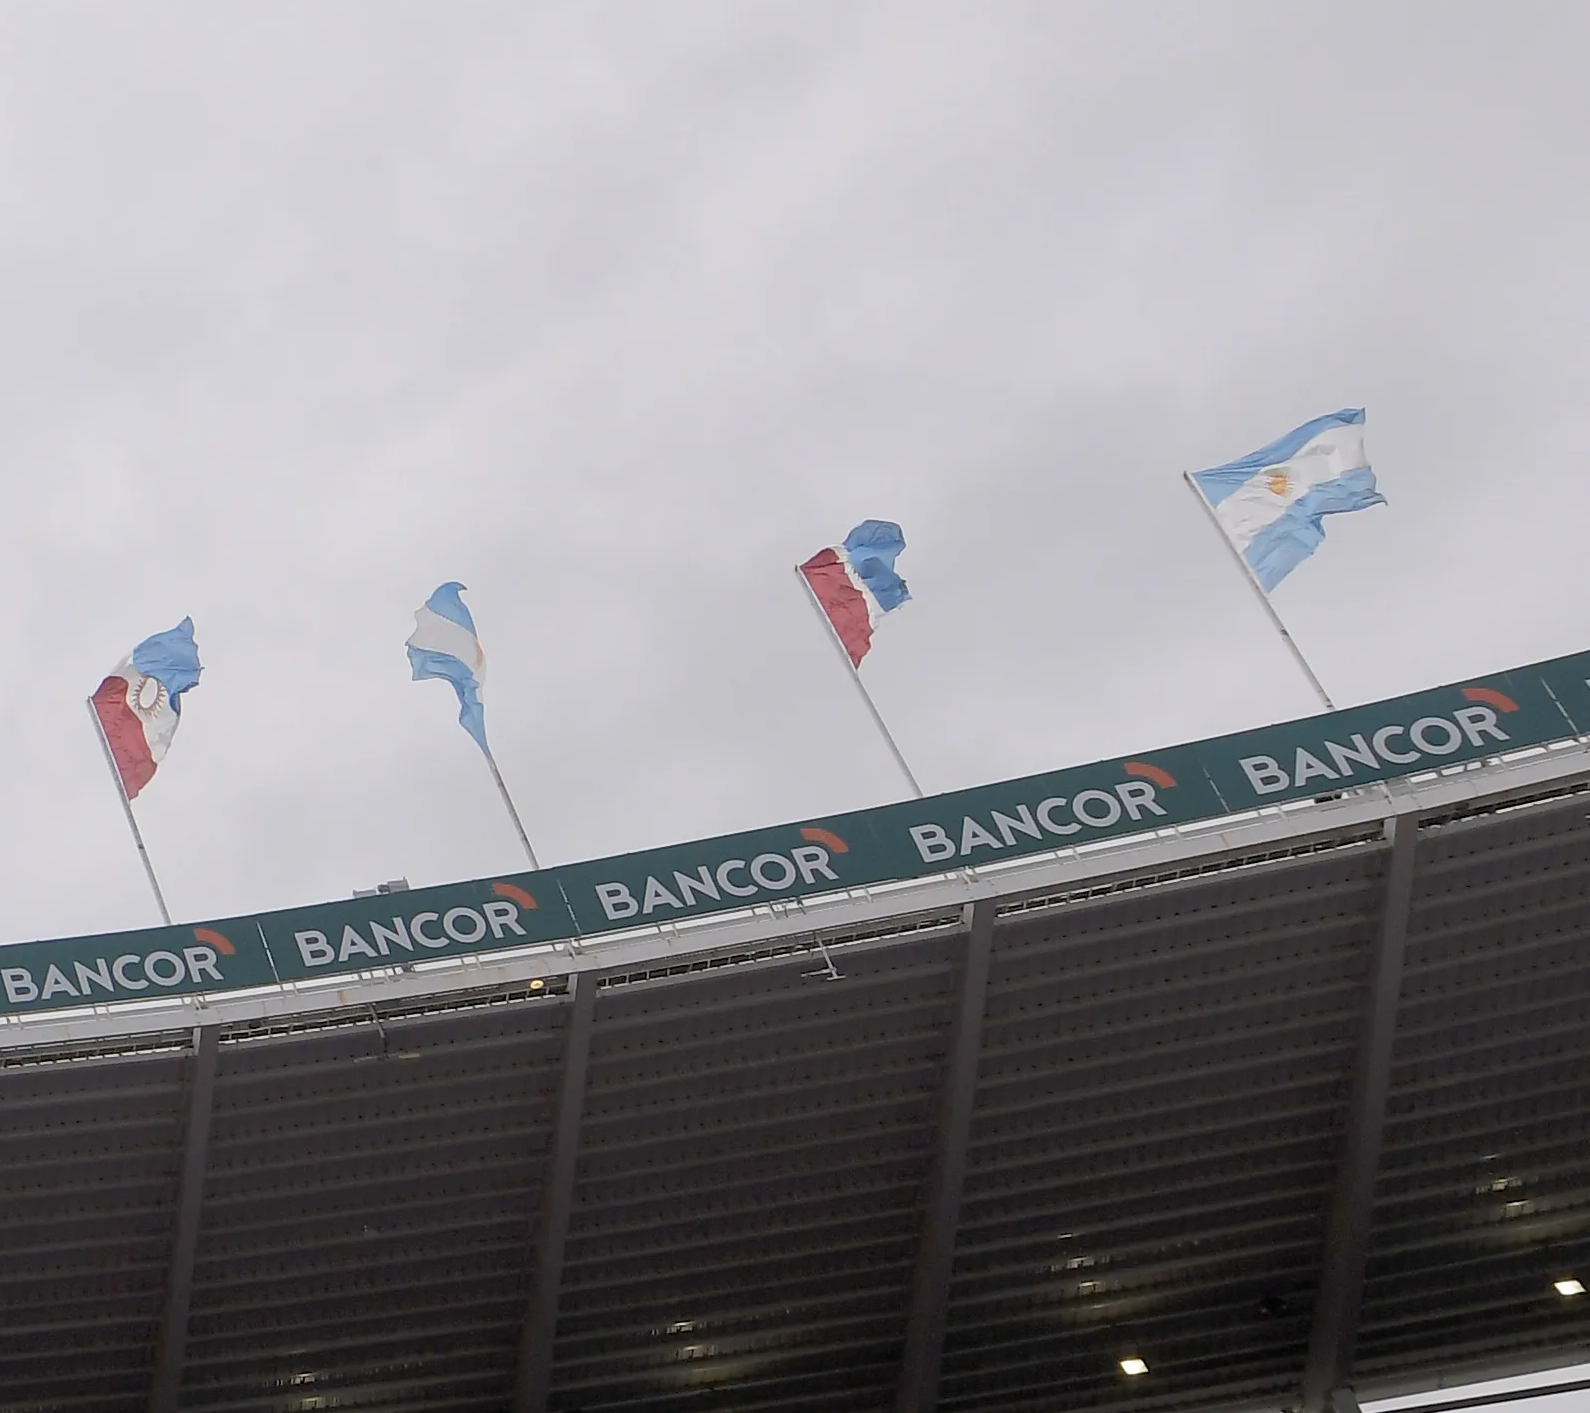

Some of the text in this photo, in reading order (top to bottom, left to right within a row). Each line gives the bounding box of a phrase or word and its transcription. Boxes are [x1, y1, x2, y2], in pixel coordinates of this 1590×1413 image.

[1238, 705, 1511, 796] BANCOR
[910, 779, 1168, 863] BANCOR
[595, 844, 839, 920] BANCOR
[293, 900, 528, 966] BANCOR
[0, 945, 224, 1003] BANCOR
